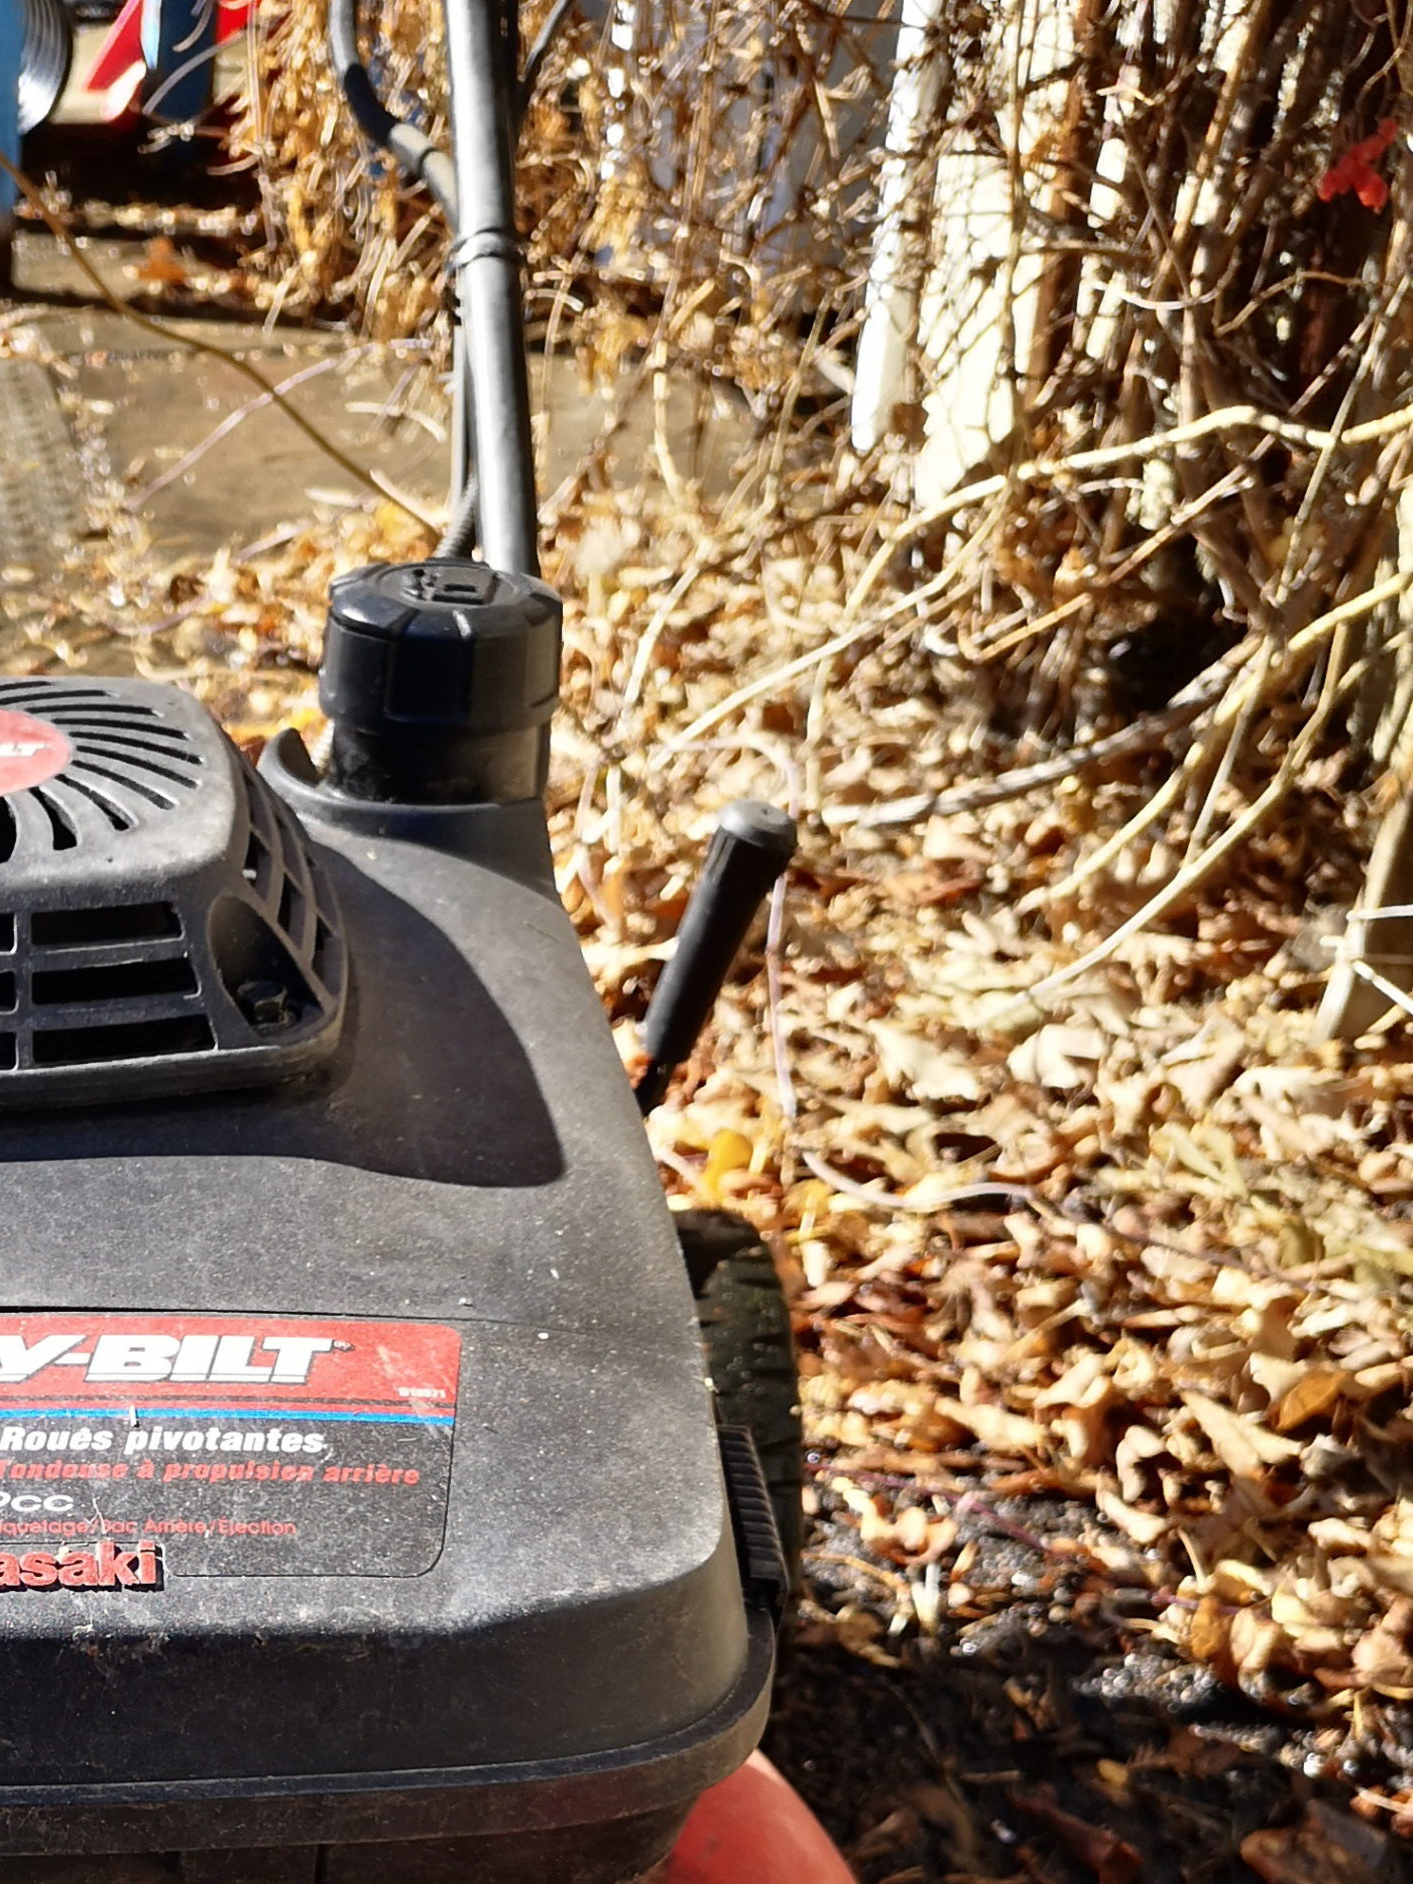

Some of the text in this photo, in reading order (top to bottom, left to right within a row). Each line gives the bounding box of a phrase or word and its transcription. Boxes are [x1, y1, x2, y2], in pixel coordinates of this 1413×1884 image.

[124, 1426, 326, 1455] pivotantes
[136, 1458, 155, 1479] à
[162, 1460, 315, 1484] propulsion
[322, 1463, 421, 1485] arrière
